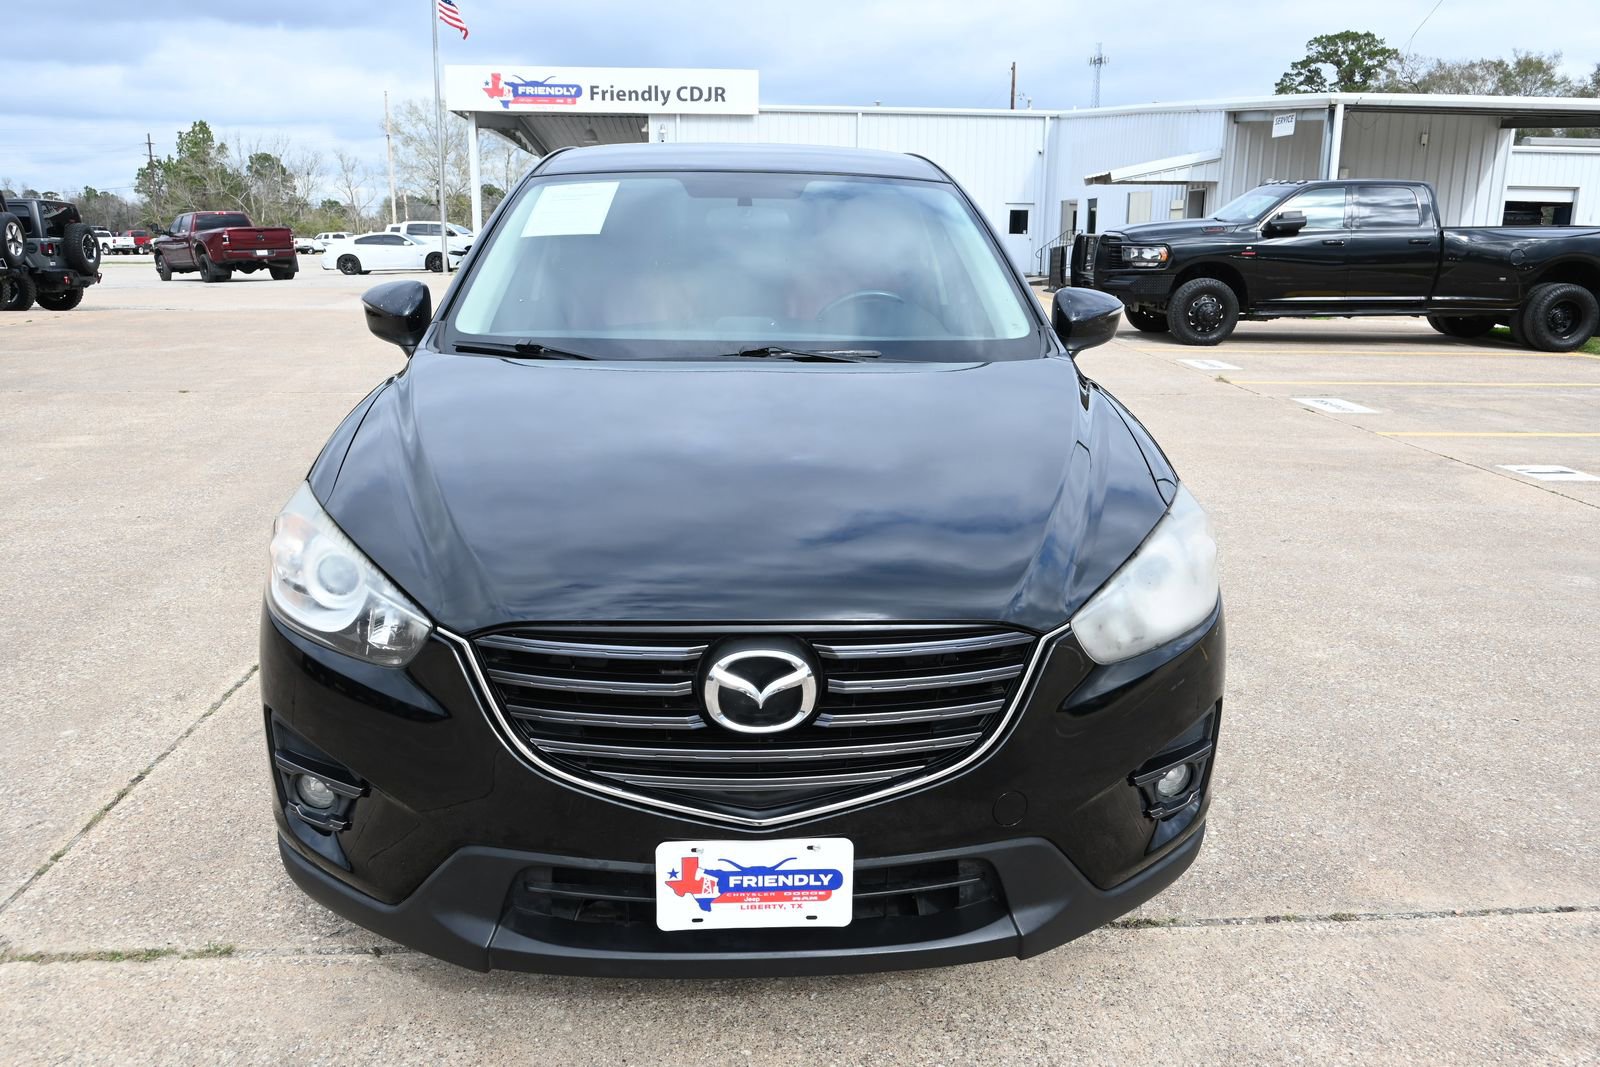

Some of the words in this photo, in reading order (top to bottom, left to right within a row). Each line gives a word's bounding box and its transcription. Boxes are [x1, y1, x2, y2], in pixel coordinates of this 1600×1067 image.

[518, 86, 577, 96] FRIENDLY
[590, 85, 671, 106] Friendly
[676, 86, 726, 102] CDJR
[1275, 115, 1294, 125] SERVICE
[729, 874, 833, 888] FRIENDLY
[740, 903, 787, 911] LIBERTY,
